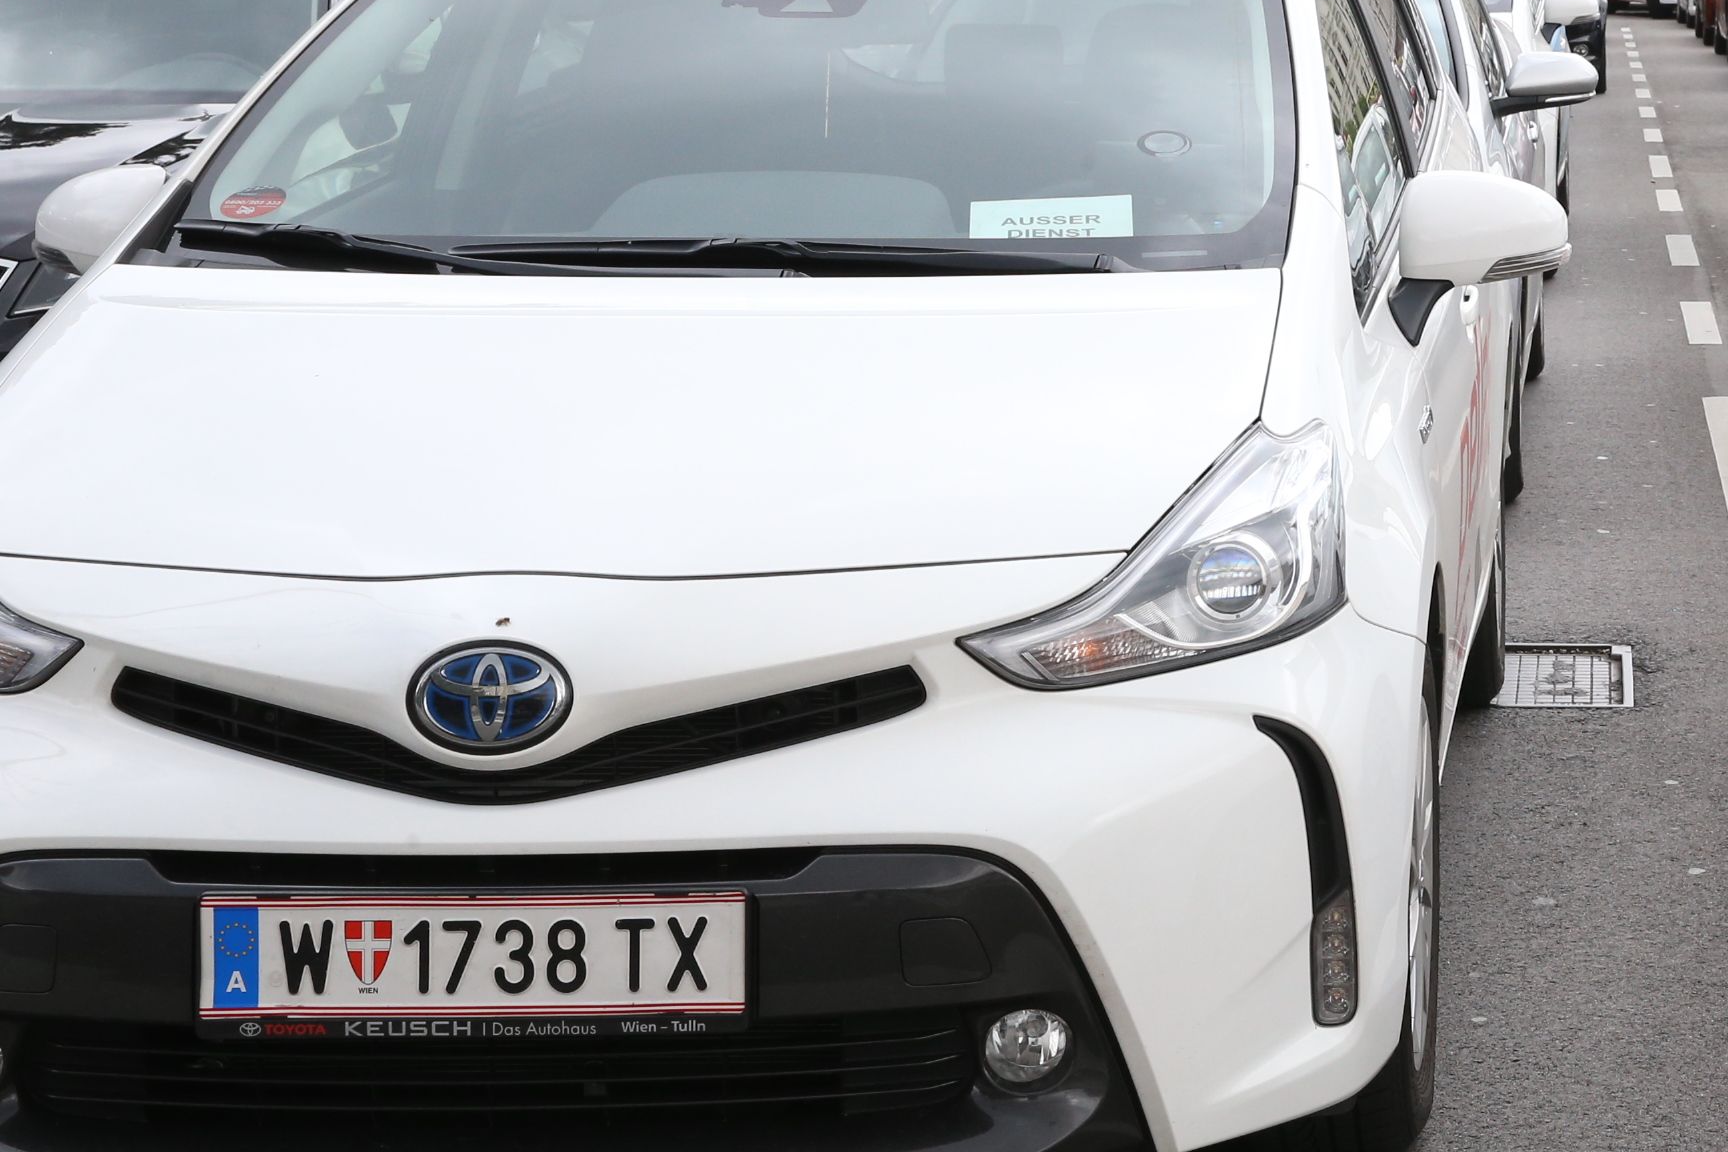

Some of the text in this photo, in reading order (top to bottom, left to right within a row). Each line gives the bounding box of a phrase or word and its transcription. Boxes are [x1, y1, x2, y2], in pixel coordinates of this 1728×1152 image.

[1001, 215, 1101, 226] AUSSER
[1008, 228, 1096, 238] DIENST
[279, 916, 709, 994] W 1738 TX
[226, 971, 247, 993] A
[264, 1024, 326, 1036] TOYOTA
[345, 1021, 471, 1037] KEUSCH
[492, 1021, 597, 1036] Das Autohaus
[621, 1019, 707, 1033] Wien Tulln
